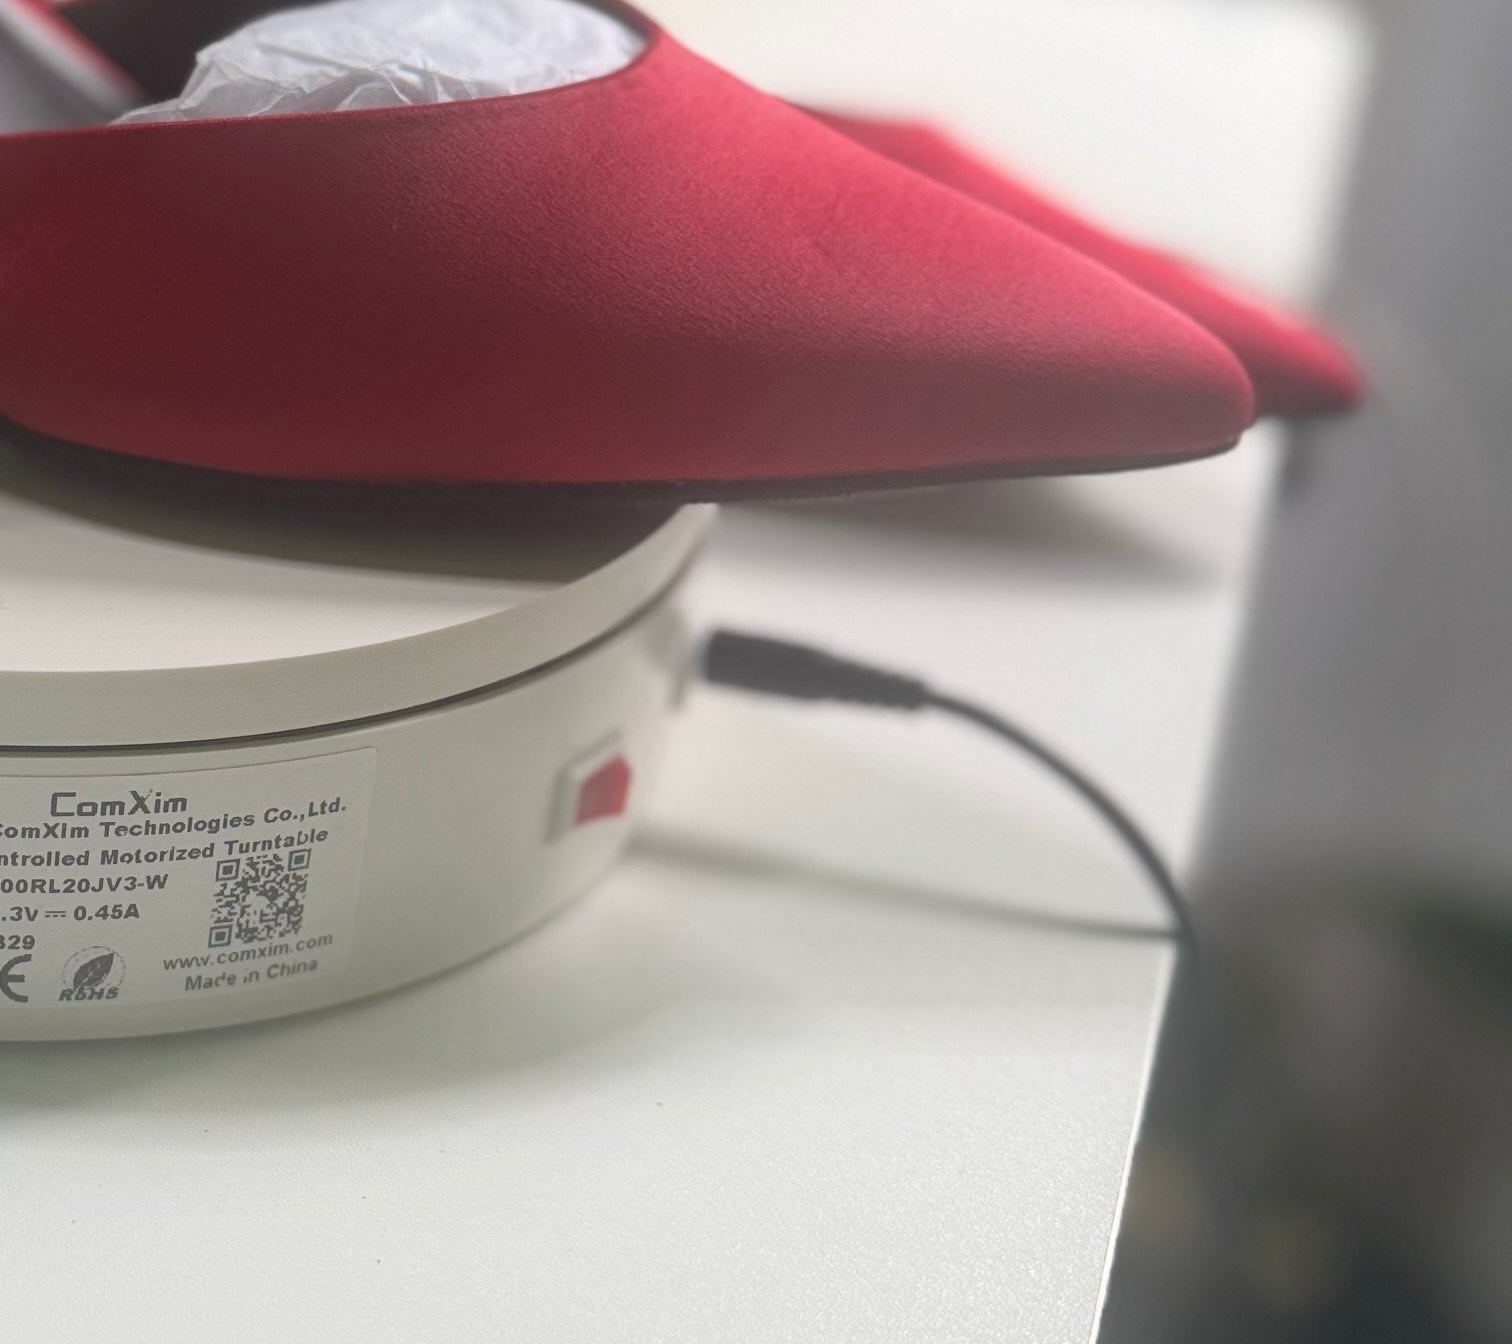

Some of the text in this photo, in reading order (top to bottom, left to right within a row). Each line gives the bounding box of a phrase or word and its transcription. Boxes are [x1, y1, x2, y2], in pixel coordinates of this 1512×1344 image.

[99, 813, 256, 838] Technologies
[100, 842, 215, 865] Motorized
[224, 828, 329, 856] Turntable
[73, 903, 140, 921] 0.45A
[163, 933, 334, 971] www.comxim.com
[266, 959, 319, 979] China
